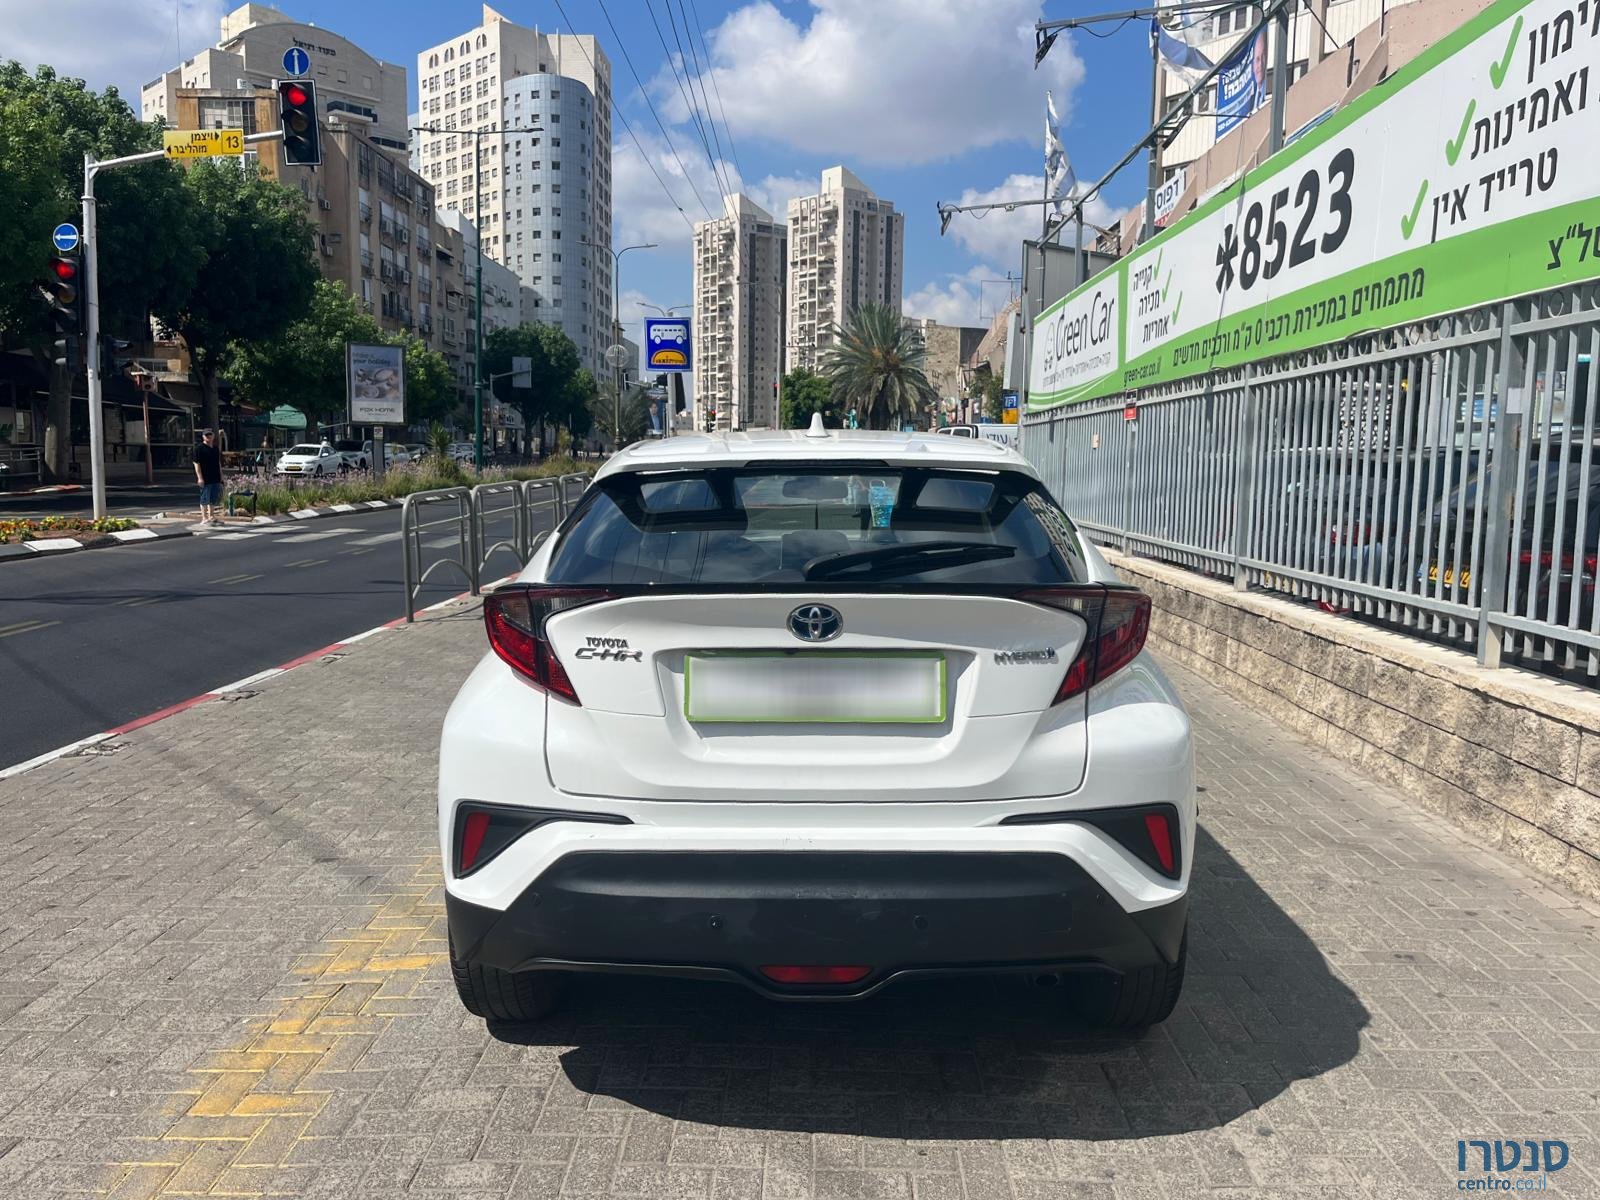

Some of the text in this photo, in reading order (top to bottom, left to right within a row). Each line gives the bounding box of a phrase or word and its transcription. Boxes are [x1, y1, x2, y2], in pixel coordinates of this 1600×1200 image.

[1470, 65, 1590, 160] ואמינות
[173, 142, 208, 154] מוהליבר
[190, 132, 214, 143] ויצמן
[226, 135, 240, 149] 13
[1156, 179, 1180, 210] דפוס
[1430, 147, 1558, 244] טרייד אין
[1133, 264, 1153, 291] קנייה
[1138, 289, 1160, 317] מכירה
[1351, 267, 1425, 317] מתמחים
[1056, 290, 1115, 362] Green Car
[1264, 313, 1290, 342] רכבי
[1291, 294, 1346, 335] במכירת
[1142, 314, 1170, 344] אחריות
[1254, 317, 1263, 346] 0
[1173, 341, 1200, 367] חדשים
[1201, 332, 1231, 360] ורכבים
[1123, 355, 1162, 388] green-car.co.il
[575, 648, 643, 662] C-HR
[585, 636, 629, 649] TOYOTA
[993, 649, 1059, 665] HYBRID
